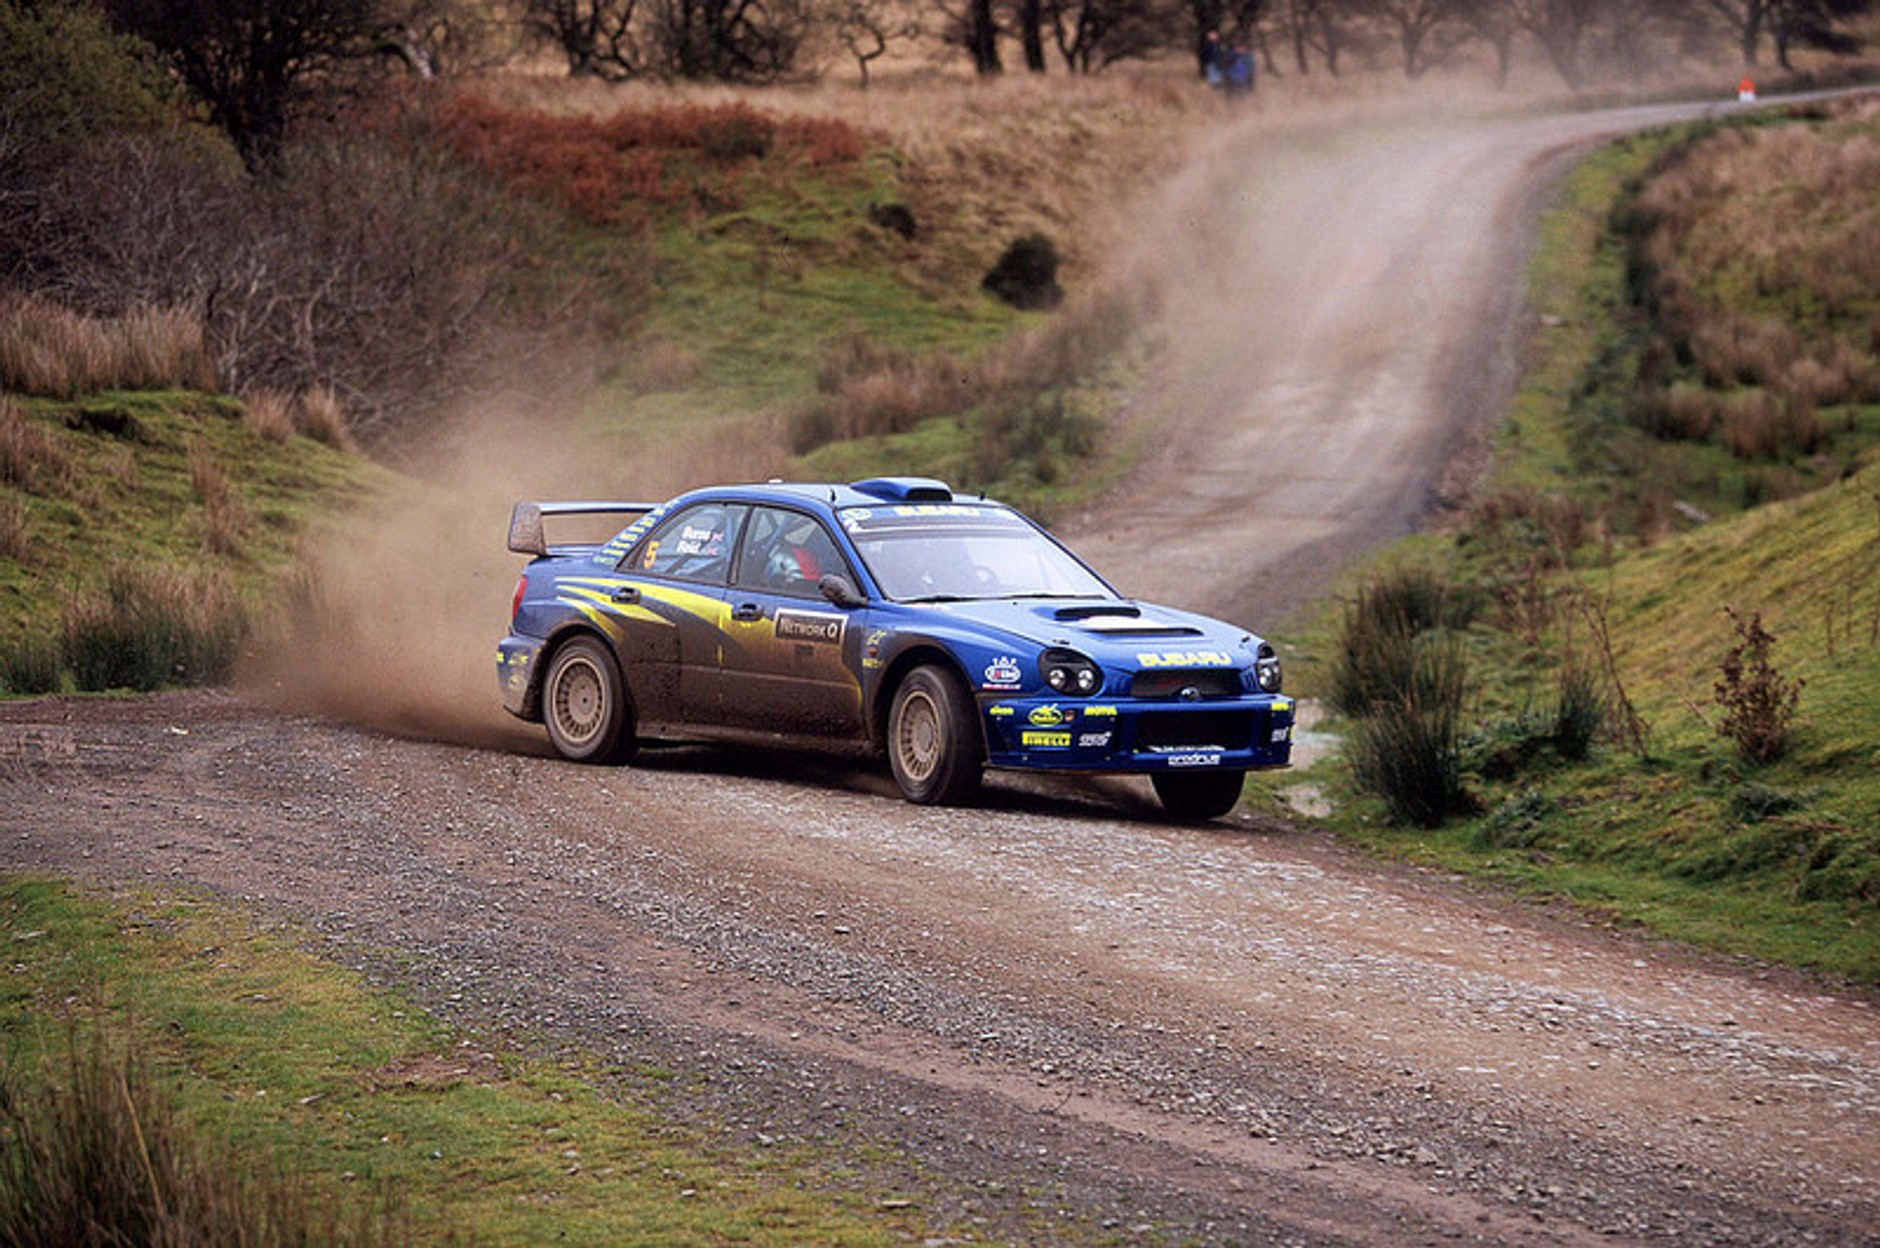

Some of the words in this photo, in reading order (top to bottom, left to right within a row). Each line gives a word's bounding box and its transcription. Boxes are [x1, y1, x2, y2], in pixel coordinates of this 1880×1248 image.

[643, 540, 660, 569] 5
[827, 623, 838, 639] Q
[1137, 653, 1232, 667] SUBARU
[1025, 733, 1070, 745] PIRELLI
